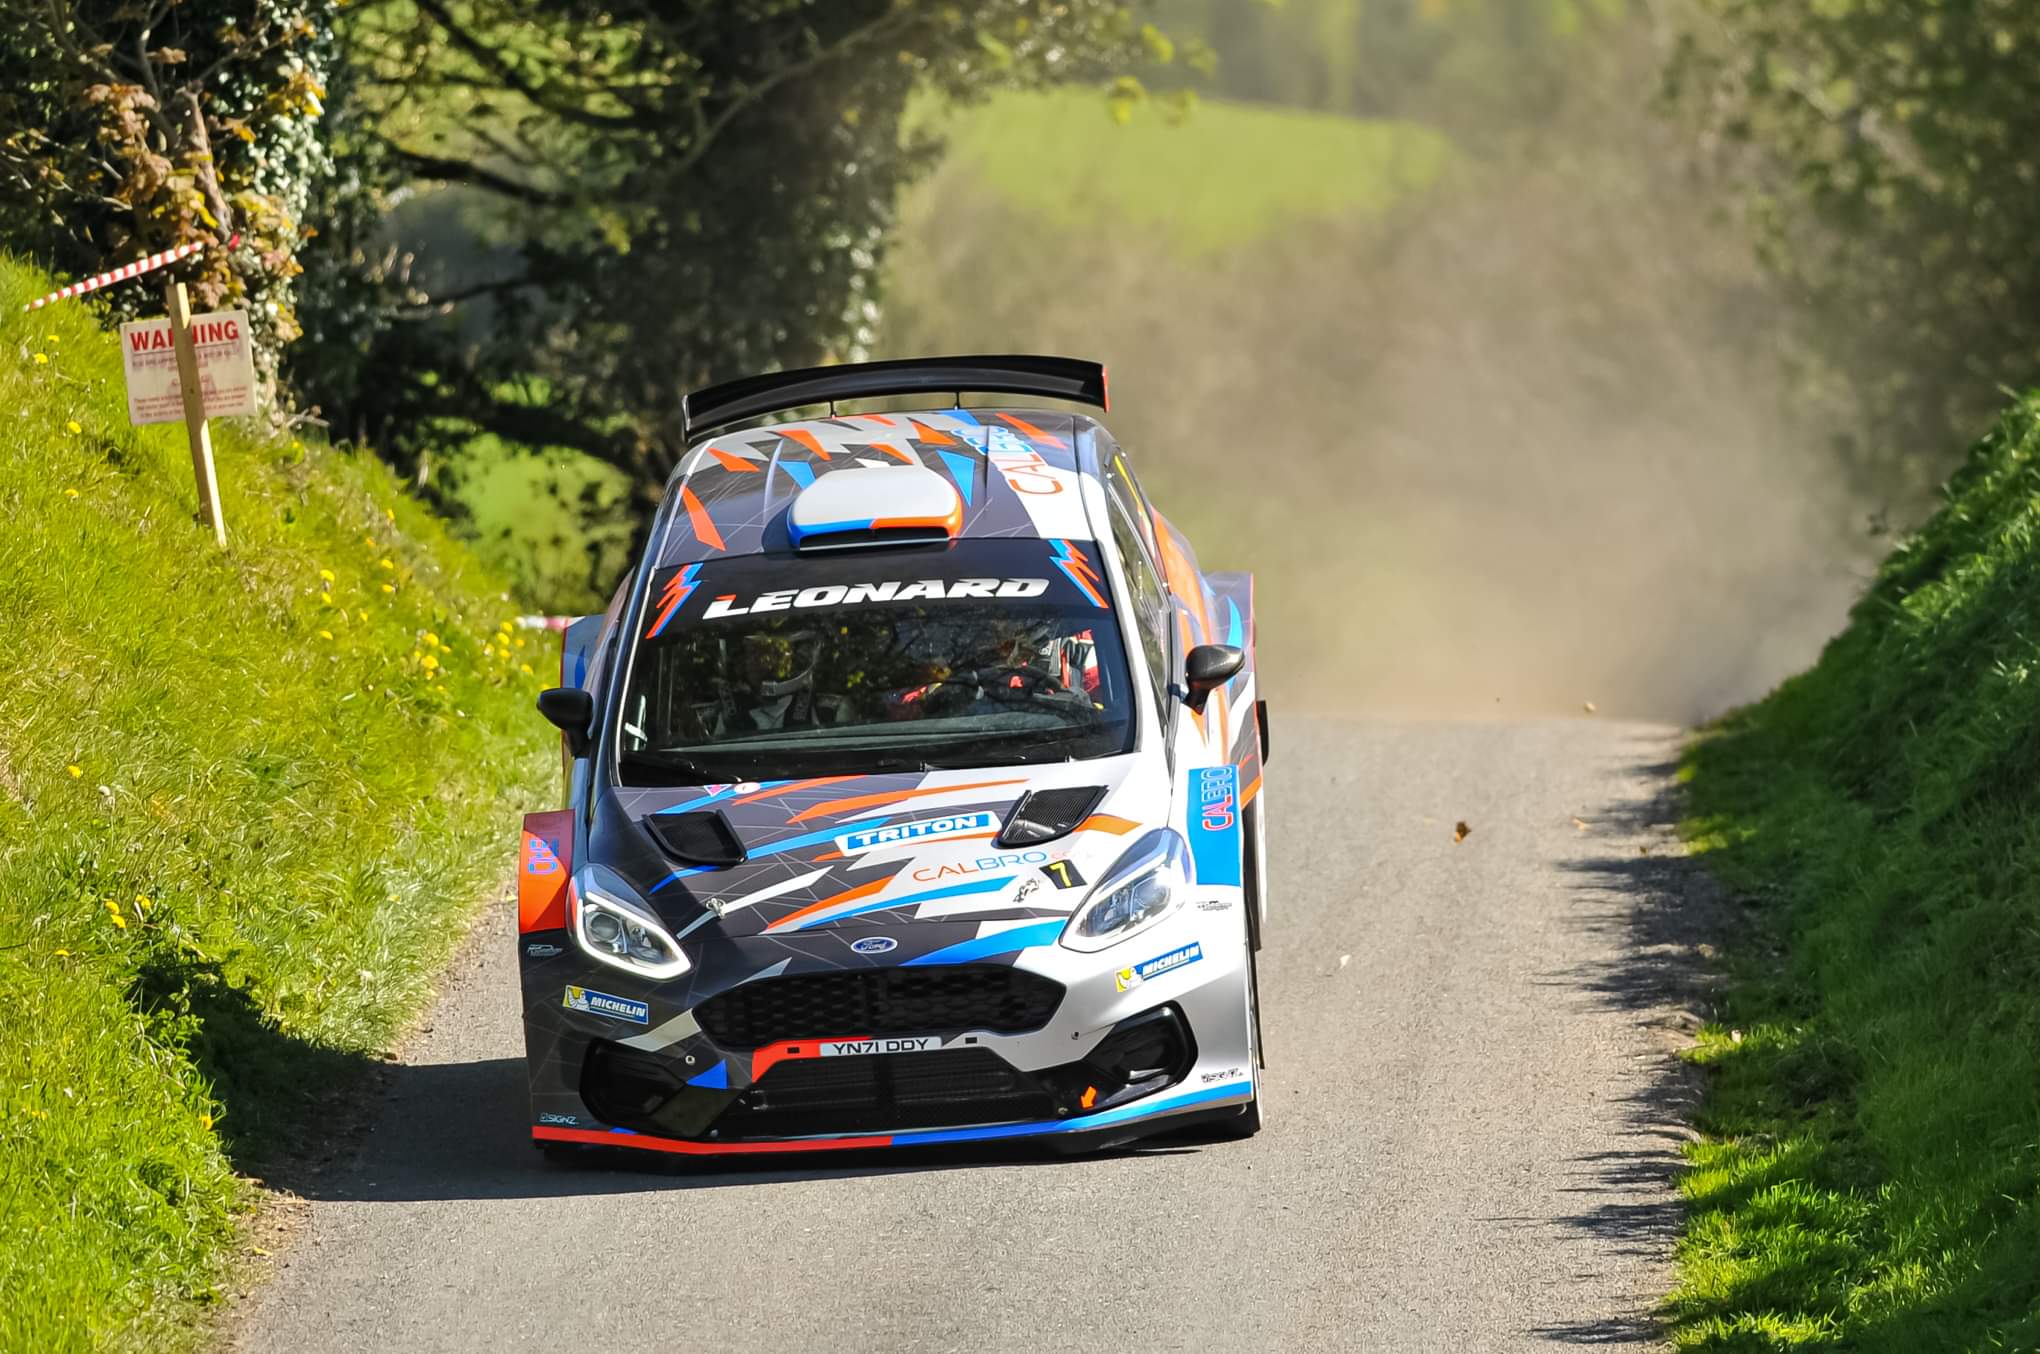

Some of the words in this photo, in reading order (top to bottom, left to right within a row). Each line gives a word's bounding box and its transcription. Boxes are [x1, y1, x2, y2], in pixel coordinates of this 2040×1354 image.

[130, 320, 239, 352] WAING
[702, 578, 1050, 620] LEONARD
[855, 816, 978, 846] TRITON
[1050, 861, 1072, 888] 7
[1141, 945, 1200, 976] MICHELIN
[590, 996, 646, 1016] MICHELIN
[833, 1041, 879, 1055] YN71
[886, 1038, 928, 1052] DDY
